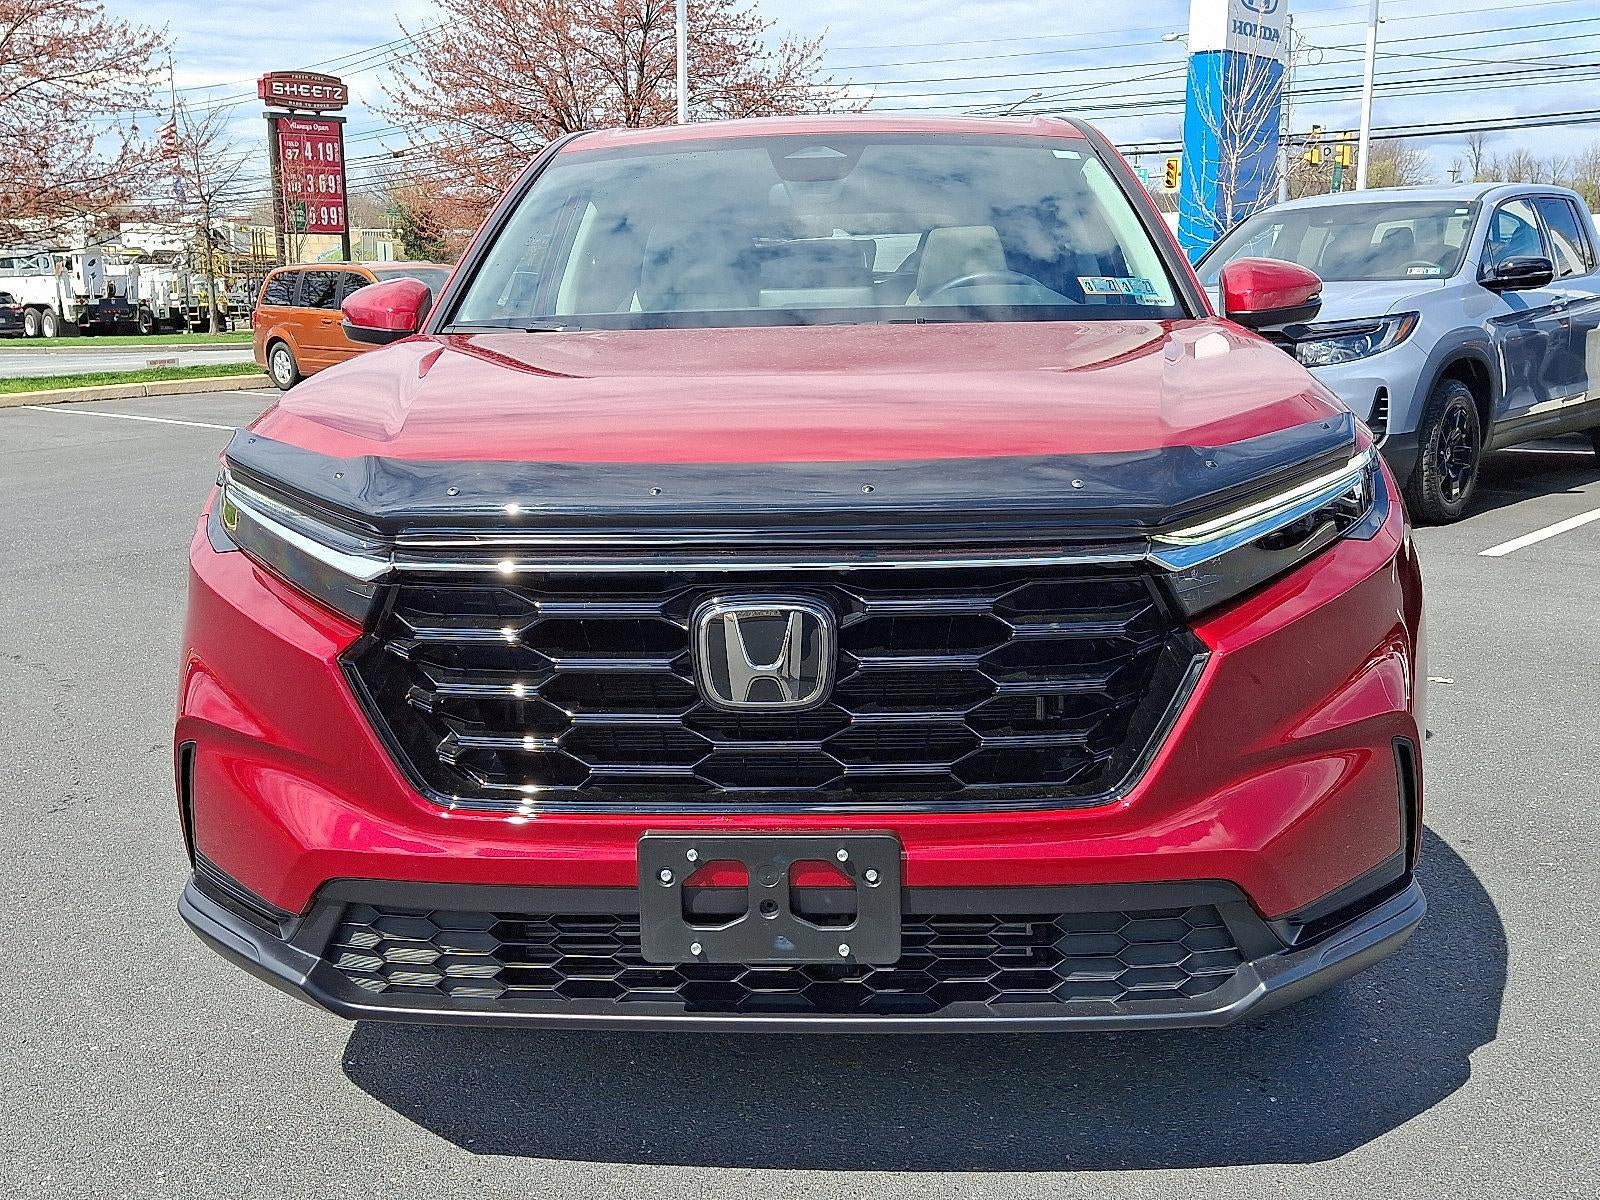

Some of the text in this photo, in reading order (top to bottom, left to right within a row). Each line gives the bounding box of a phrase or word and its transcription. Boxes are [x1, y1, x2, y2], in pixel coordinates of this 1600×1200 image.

[1232, 19, 1281, 43] HONDA
[272, 82, 343, 100] SHEETZ
[313, 123, 330, 132] Open
[285, 149, 300, 160] 87
